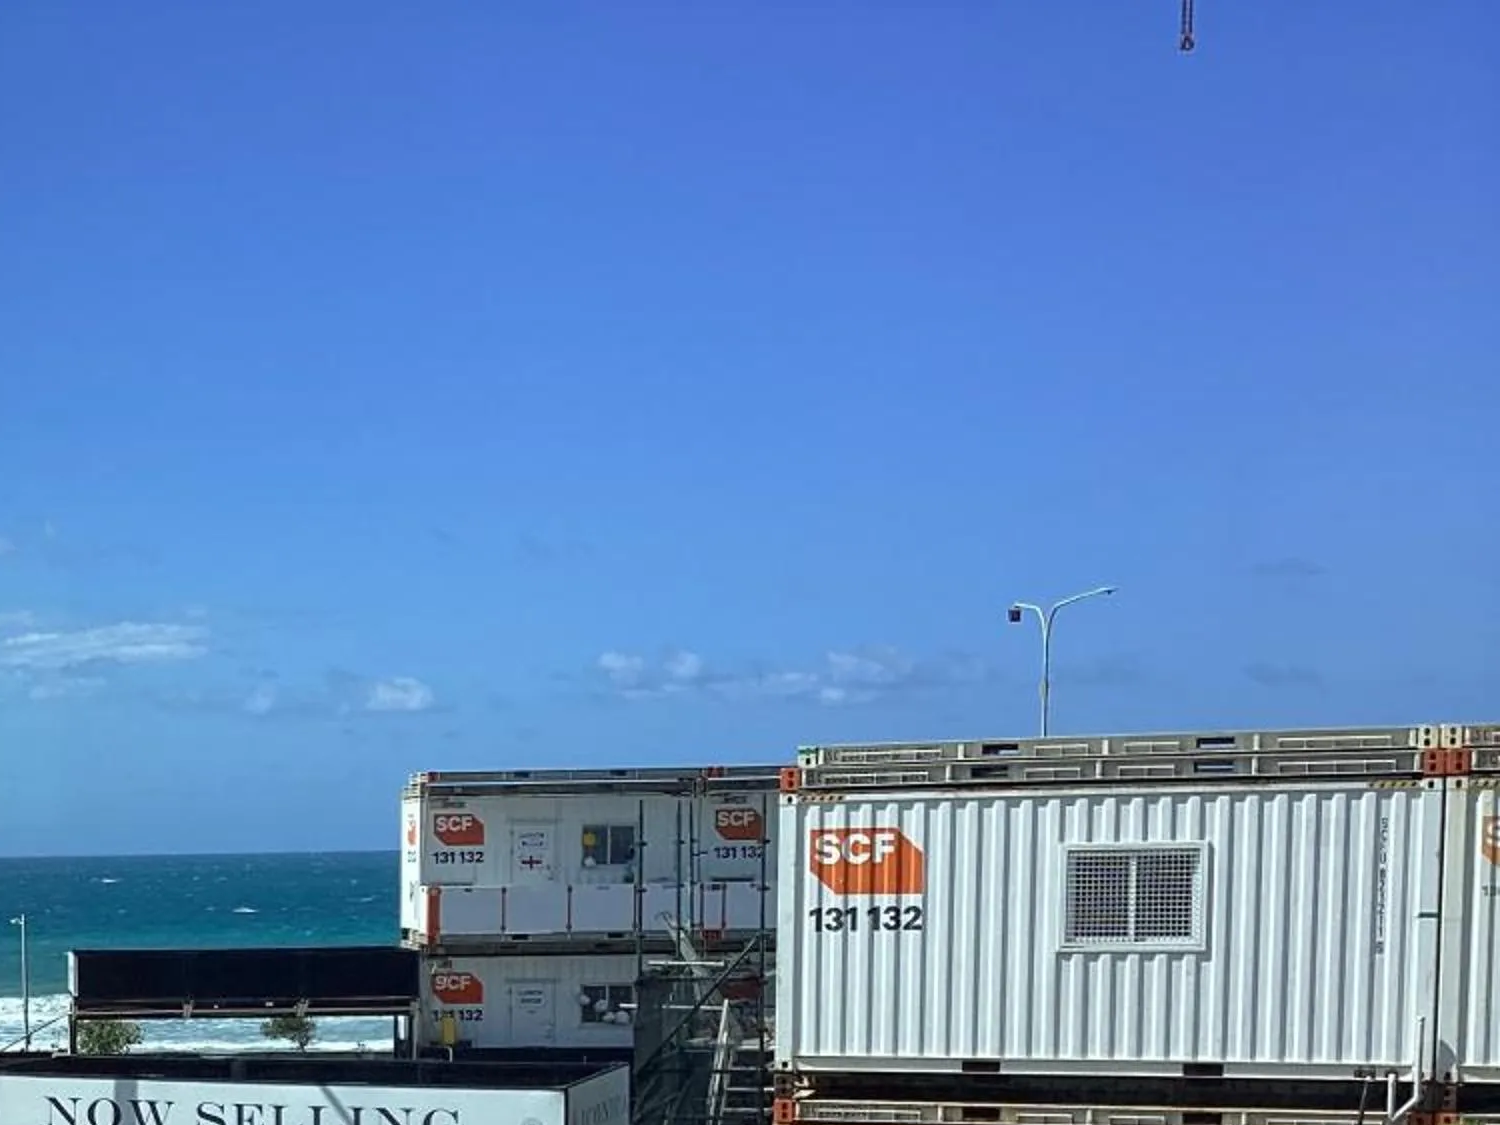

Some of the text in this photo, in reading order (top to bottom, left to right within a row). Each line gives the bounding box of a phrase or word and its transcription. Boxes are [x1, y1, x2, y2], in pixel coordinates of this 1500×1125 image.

[435, 816, 474, 832] SCF
[718, 811, 756, 827] SCF
[714, 846, 764, 859] 131 132
[815, 833, 896, 865] SCF
[433, 852, 485, 864] 131 132
[809, 905, 923, 932] 131 132
